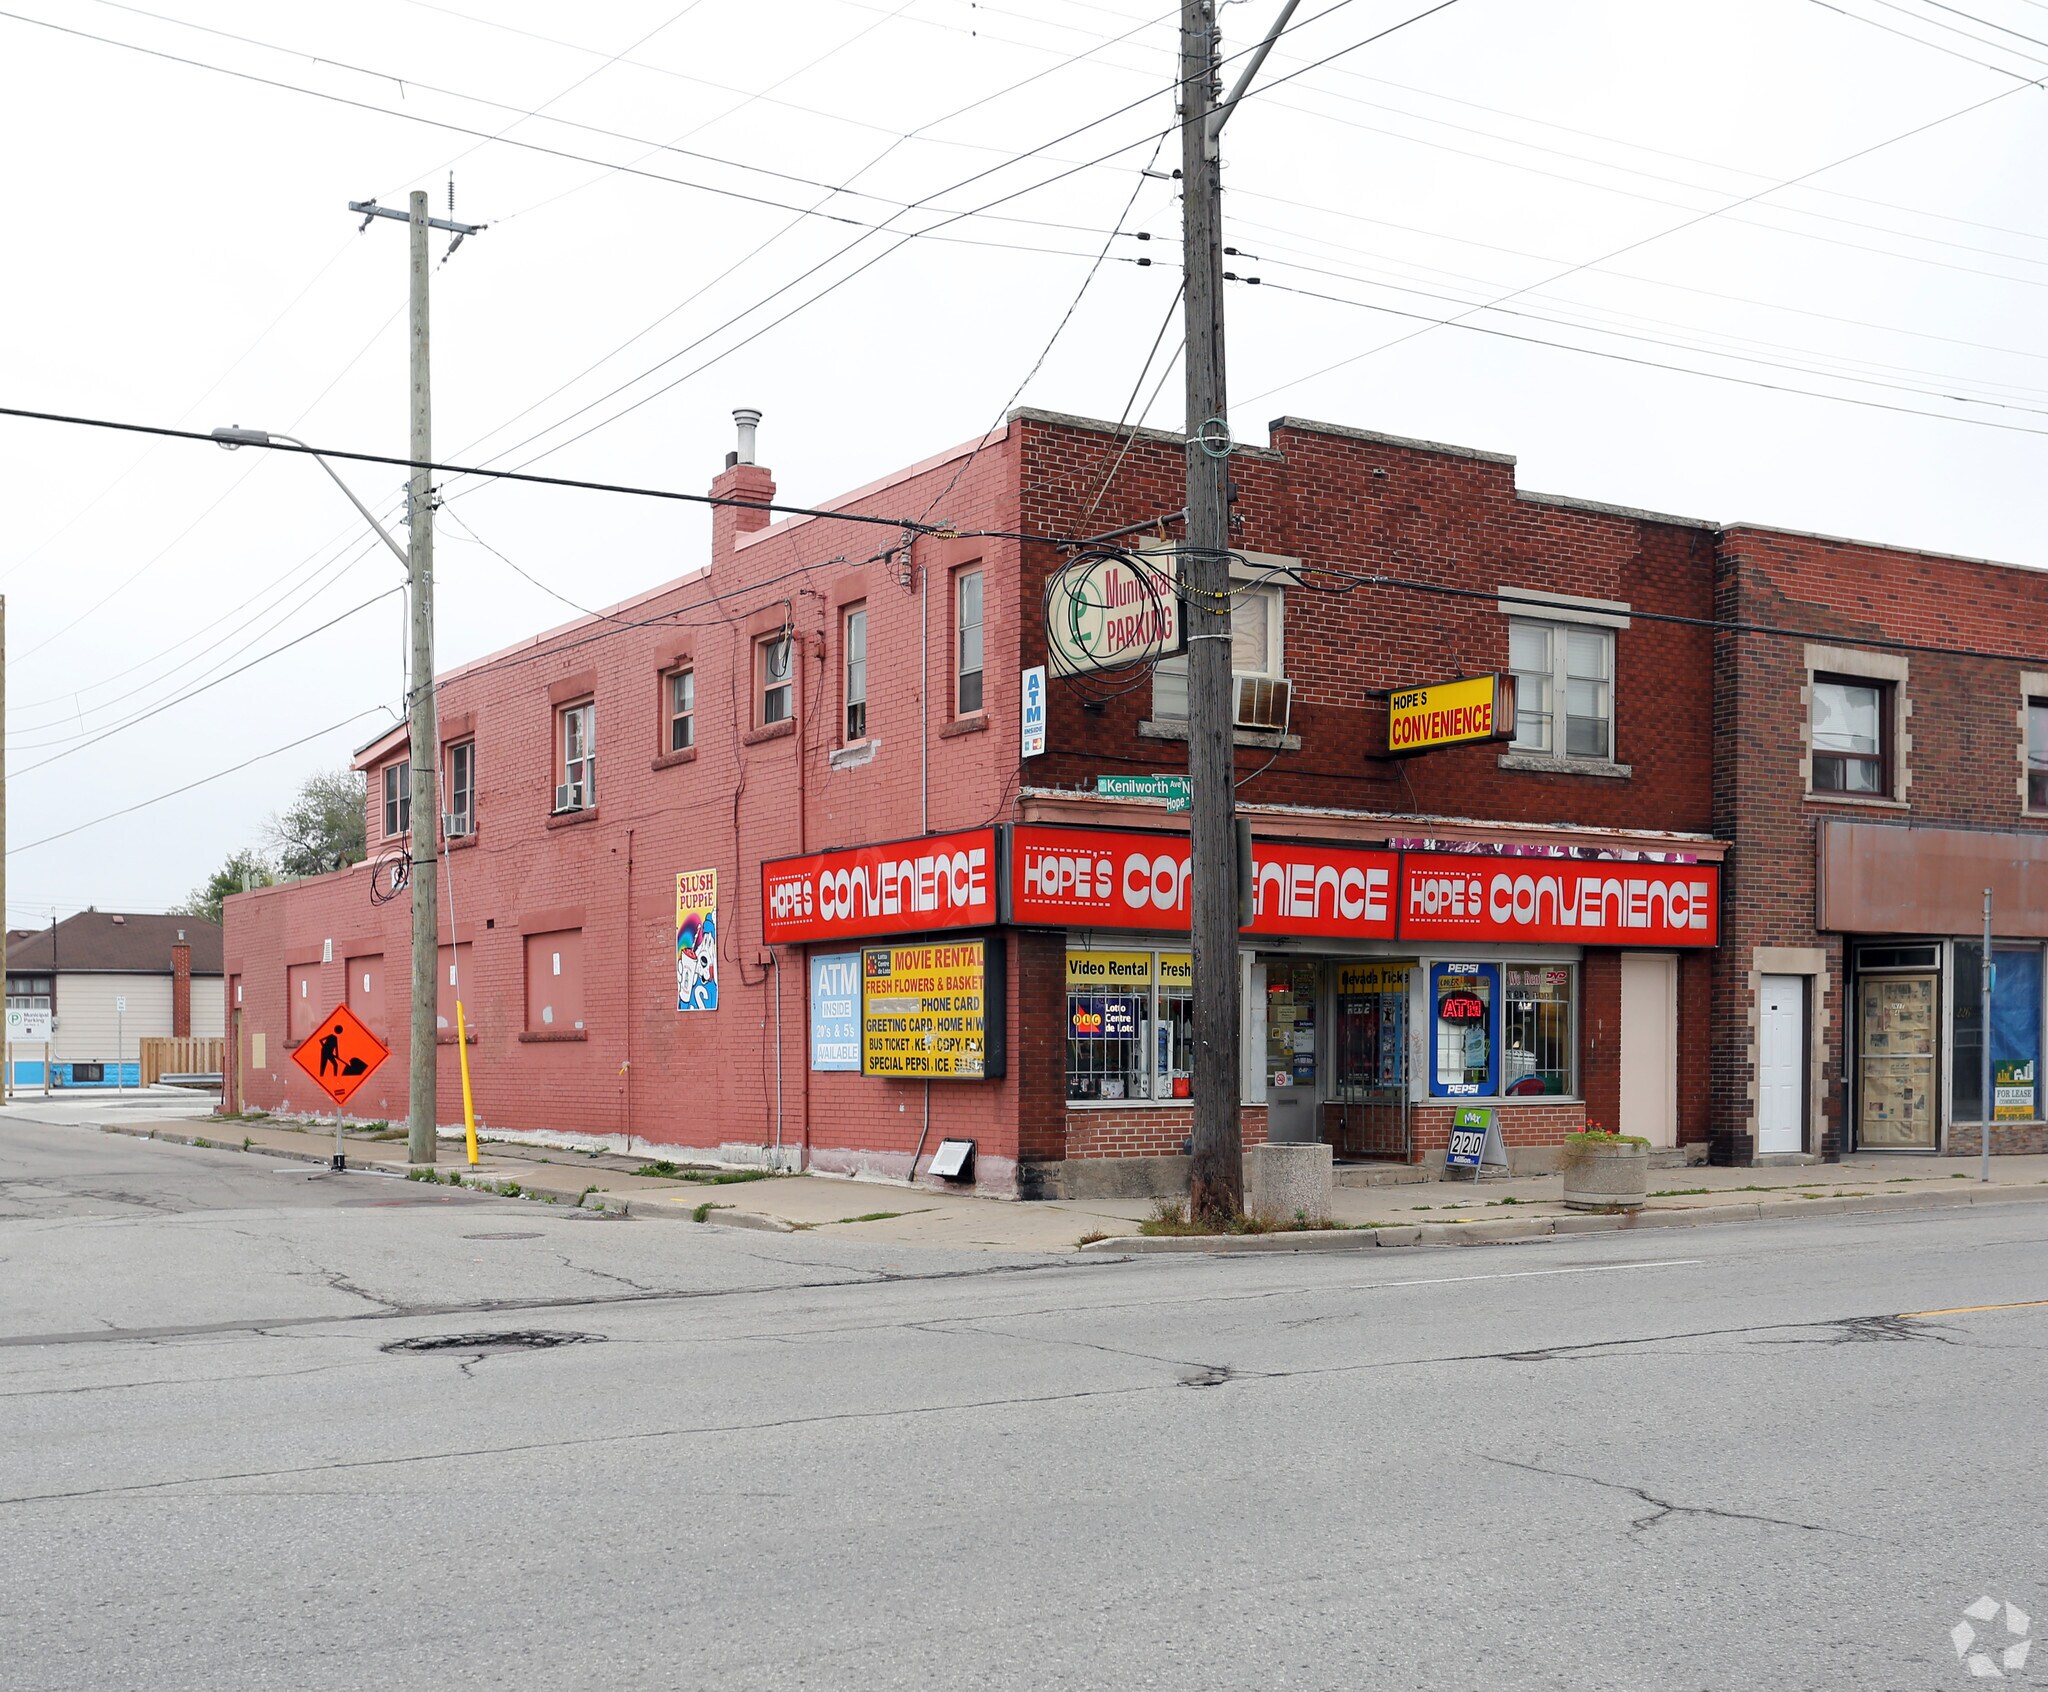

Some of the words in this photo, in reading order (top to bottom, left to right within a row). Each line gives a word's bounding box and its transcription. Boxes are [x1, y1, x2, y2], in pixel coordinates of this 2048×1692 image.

[1105, 555, 1171, 609] Municipal
[1107, 606, 1173, 653] PARKING
[1027, 674, 1041, 723] ATM
[1393, 691, 1427, 710] HOPE'S
[1024, 726, 1042, 735] INSIDE
[1392, 703, 1491, 745] CONVENIENCE
[1107, 779, 1168, 793] Kenilworth
[1170, 780, 1181, 788] Ave
[1182, 781, 1190, 794] N
[1166, 797, 1185, 811] Hope
[1024, 851, 1112, 898] HOPE'S
[680, 873, 713, 894] SLUSH
[770, 874, 812, 919] HOPE'S
[819, 848, 986, 921] CONVENIENCE
[1410, 874, 1482, 916] HOPE'S
[1489, 873, 1708, 929] CONVENIENCE
[895, 950, 931, 971] MOVIE
[935, 946, 984, 968] RENTAL
[1069, 960, 1105, 975] Video
[1109, 961, 1148, 976] Rental
[1161, 962, 1191, 977] Fresh
[1448, 964, 1479, 973] PEPSI
[818, 963, 858, 997] ATM
[866, 980, 892, 994] FRESH
[895, 977, 934, 993] FLOWERS
[938, 977, 943, 991] &
[946, 975, 984, 991] BASKET
[1342, 970, 1378, 984] Nevada
[1508, 971, 1521, 985] We
[1546, 971, 1567, 979] DVD
[823, 1002, 850, 1016] INSIDE
[922, 997, 951, 1012] PHONE
[954, 996, 980, 1011] CARD
[1105, 1004, 1126, 1013] Lotto
[1443, 999, 1481, 1017] ATM
[866, 1018, 906, 1032] GREETING
[937, 1018, 963, 1031] HOME
[966, 1017, 984, 1031] H/W
[1074, 1014, 1101, 1026] OLG
[1105, 1014, 1131, 1022] Centre
[816, 1024, 831, 1038] 20's
[834, 1024, 840, 1038] &
[843, 1023, 855, 1037] 5's
[1105, 1024, 1115, 1032] de
[1117, 1024, 1134, 1033] Loto
[818, 1045, 858, 1060] AVAILABLE
[870, 1038, 882, 1050] BUS
[965, 1038, 983, 1052] FAX
[870, 1056, 903, 1070] SPECIAL
[1447, 1084, 1479, 1094] PEPSI
[1454, 1156, 1471, 1164] Million
